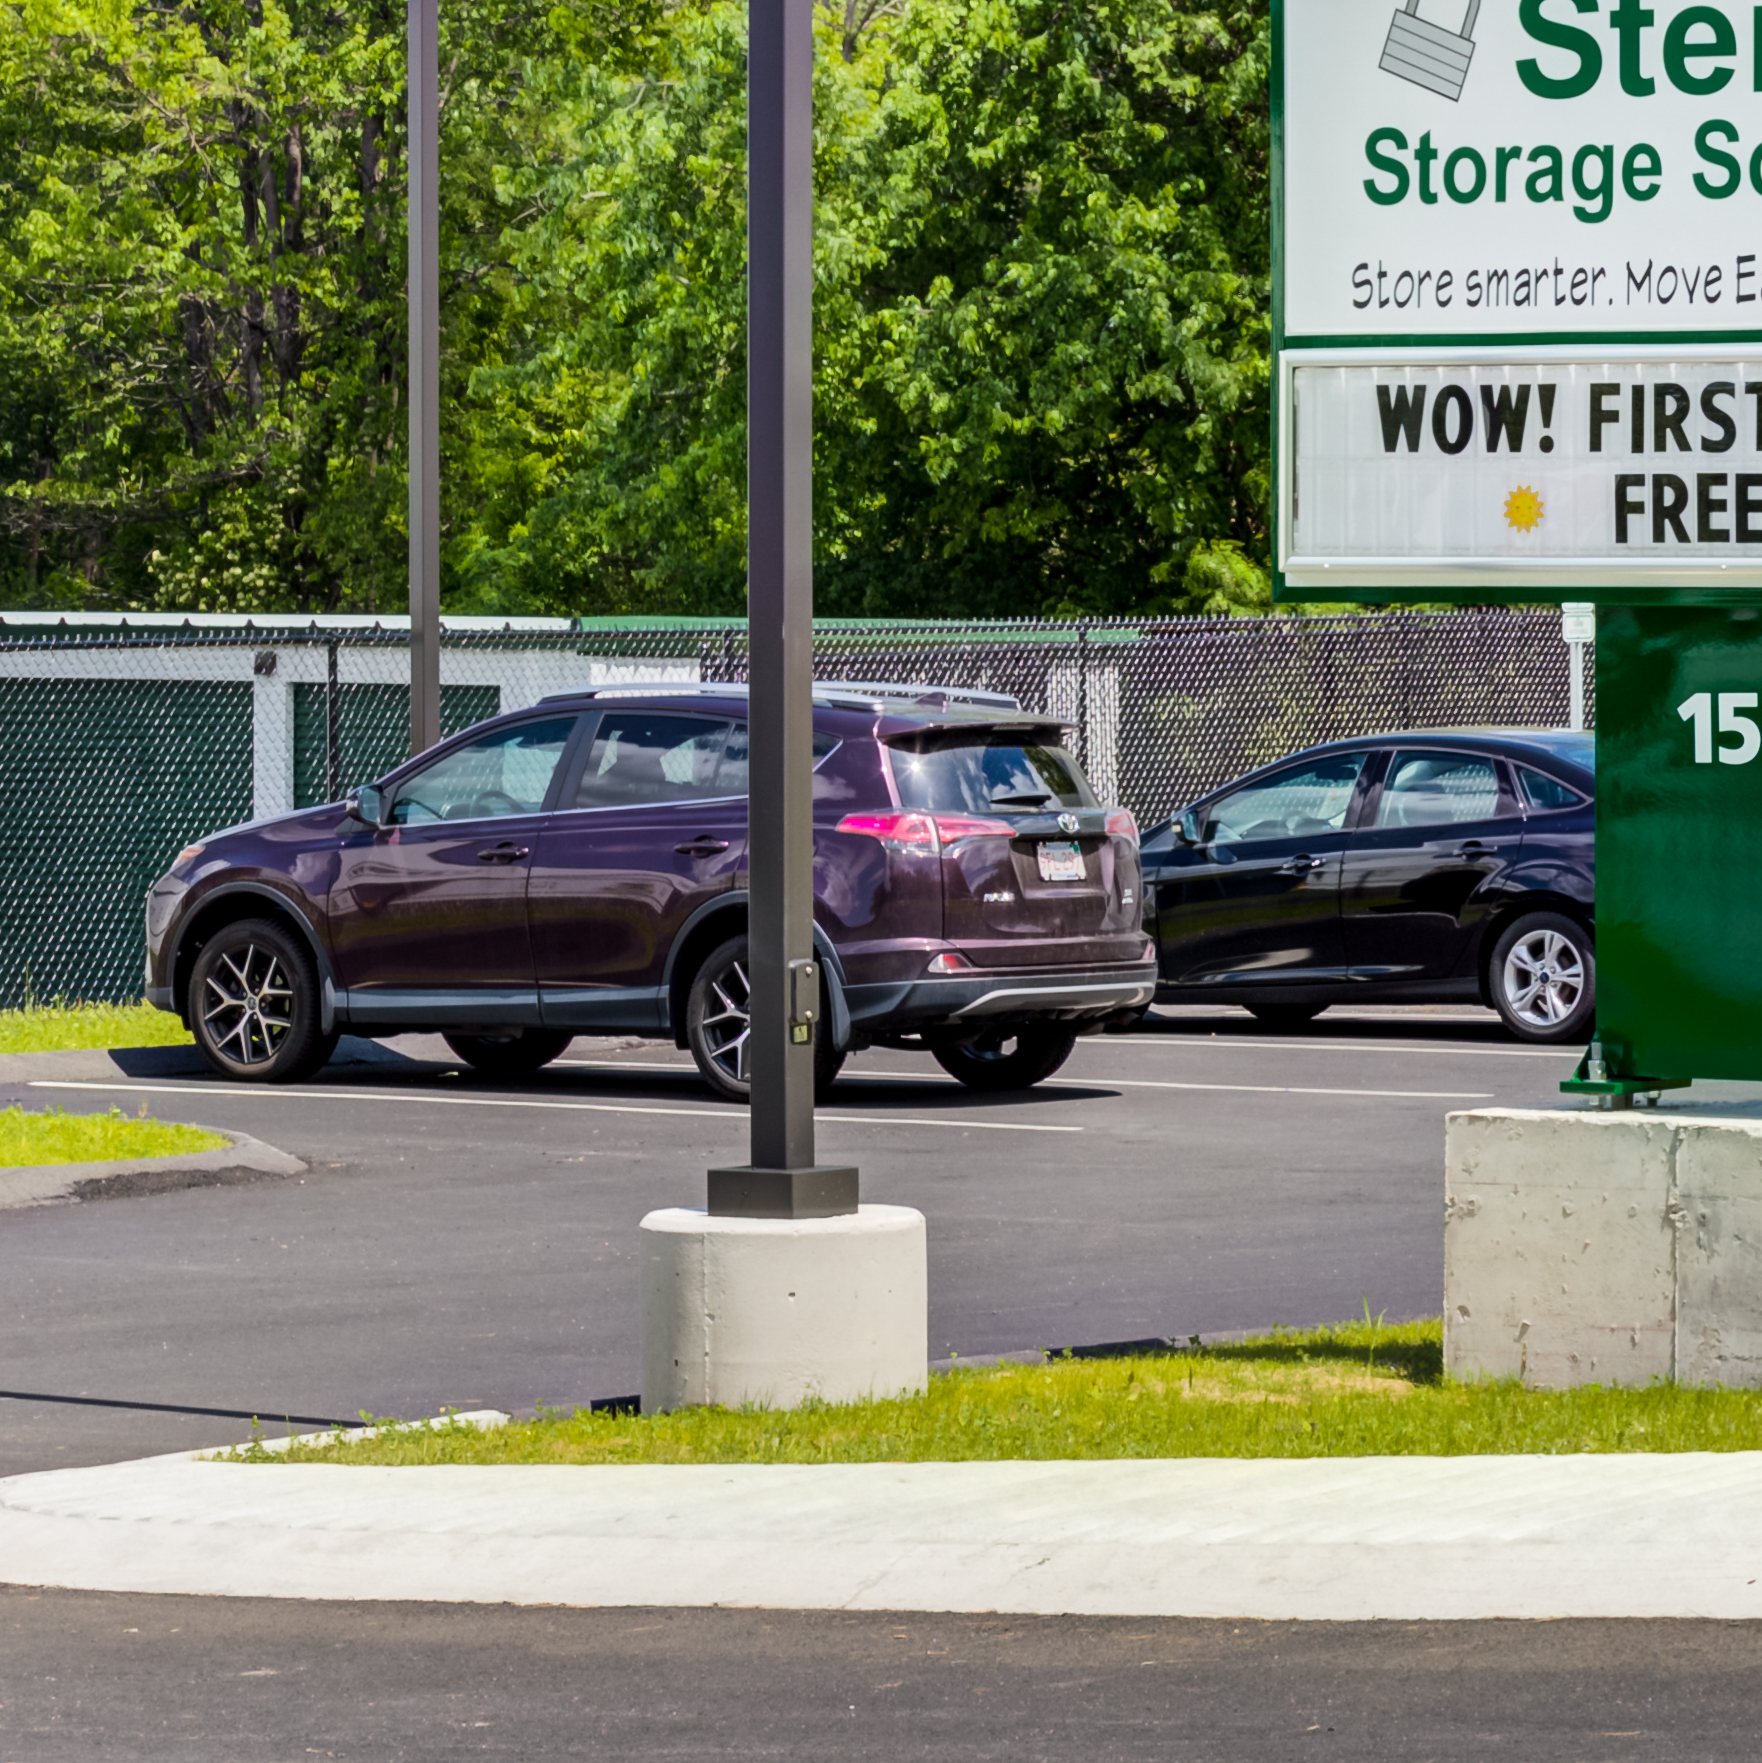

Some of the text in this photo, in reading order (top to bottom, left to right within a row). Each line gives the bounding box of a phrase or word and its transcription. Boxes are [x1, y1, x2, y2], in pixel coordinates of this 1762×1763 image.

[1364, 128, 1661, 223] Storage
[1353, 263, 1452, 308] Store
[1467, 258, 1612, 306] smarter.
[1627, 260, 1721, 304] Move
[1377, 384, 1556, 454] WOW!
